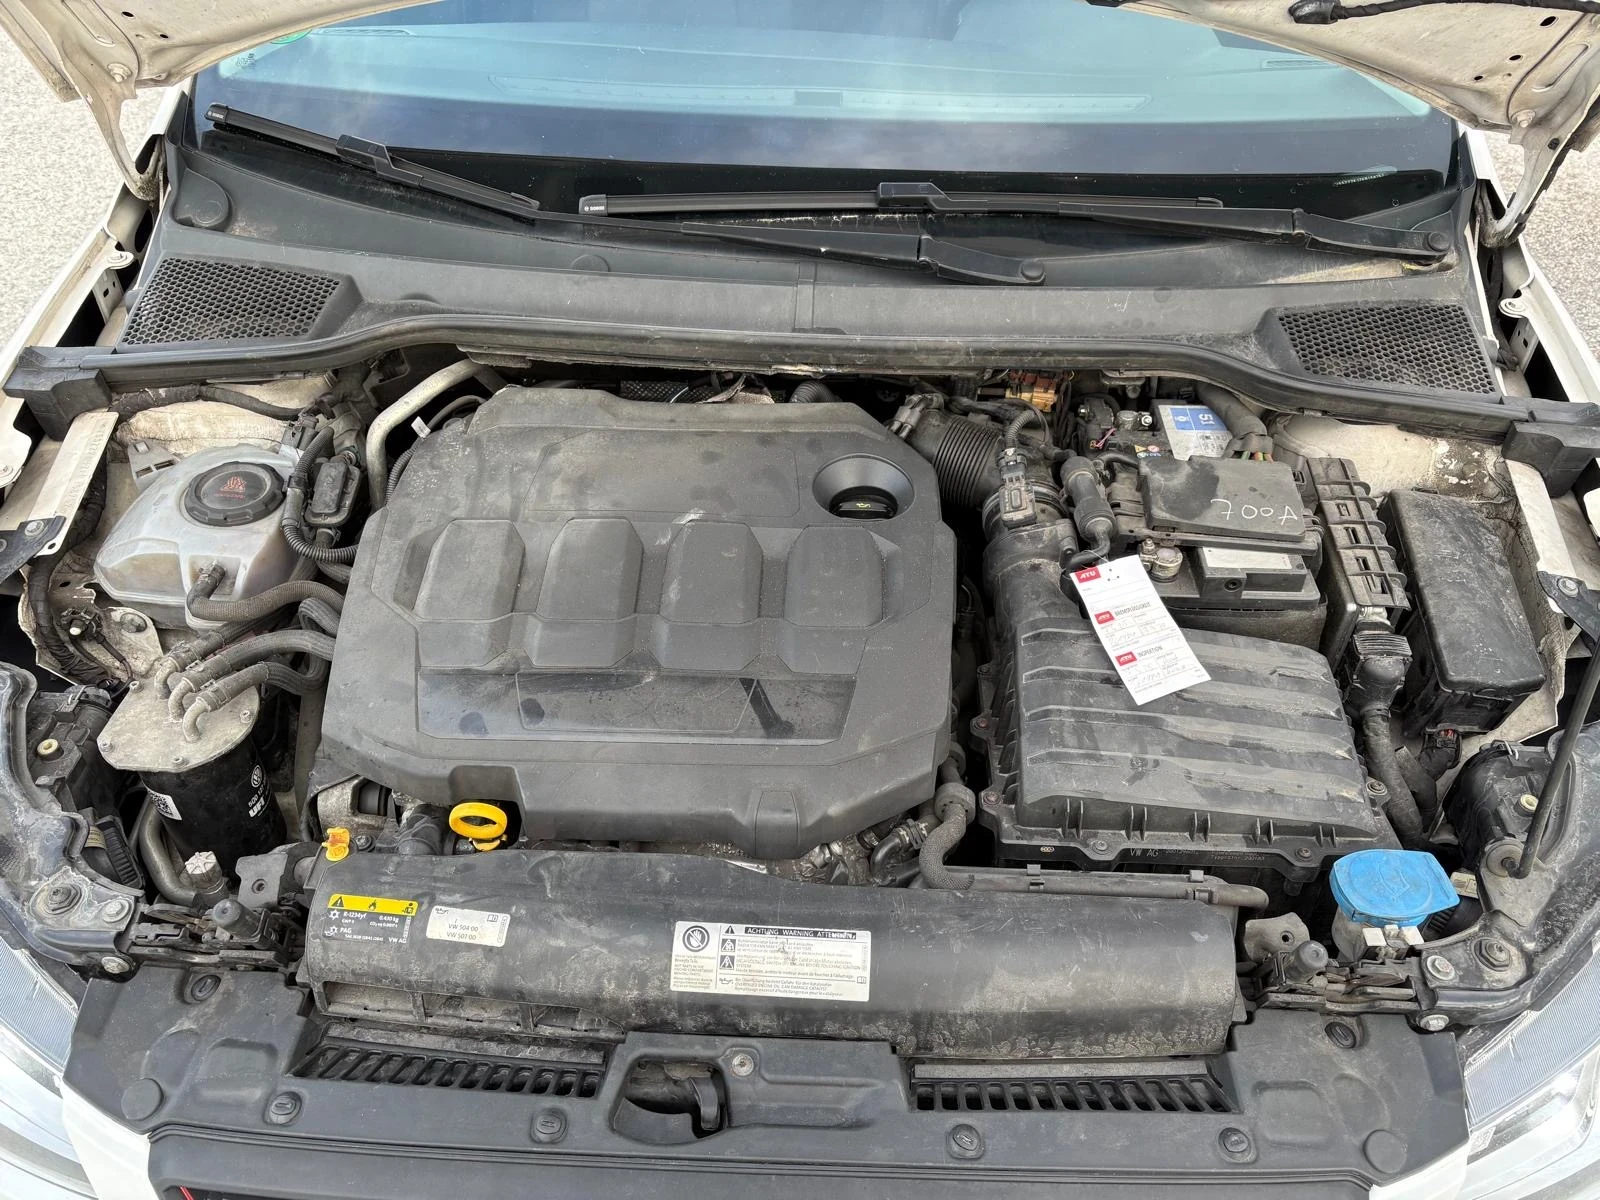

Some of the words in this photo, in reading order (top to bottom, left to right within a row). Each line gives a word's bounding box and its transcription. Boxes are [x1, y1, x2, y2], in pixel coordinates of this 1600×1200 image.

[1211, 498, 1298, 526] 700A
[1080, 570, 1096, 580] ATU
[446, 931, 457, 939] VW
[747, 928, 779, 936] ACHTUNG
